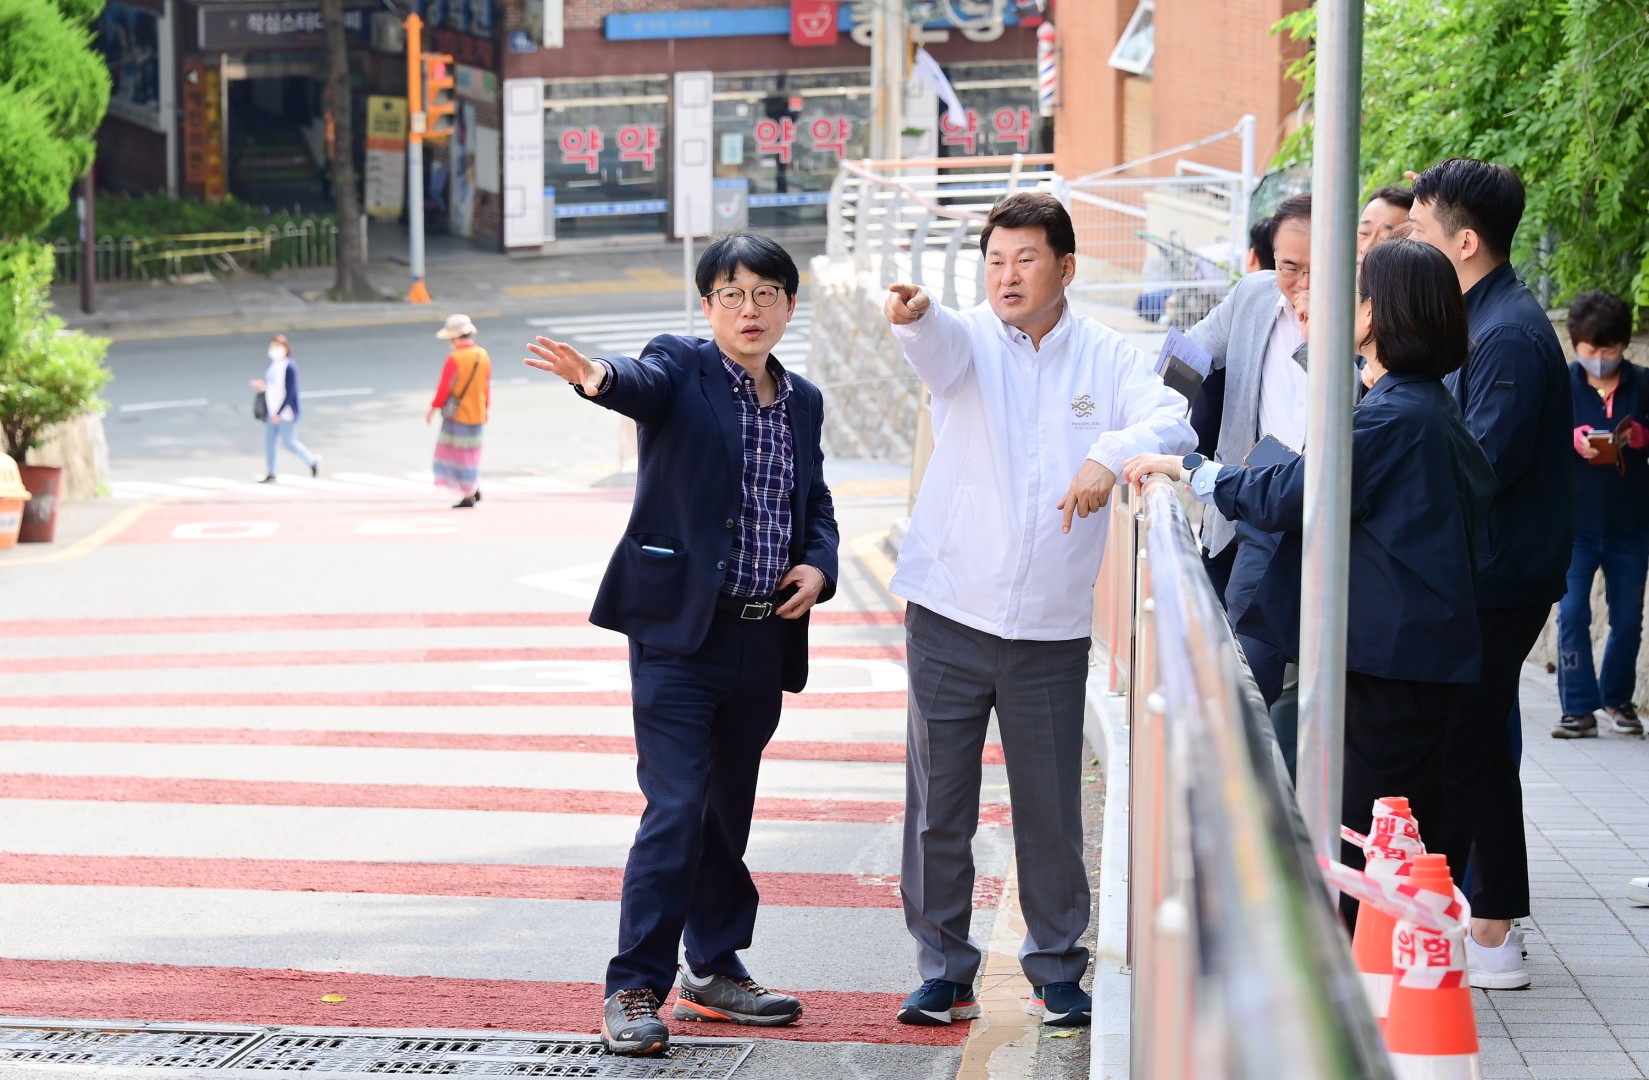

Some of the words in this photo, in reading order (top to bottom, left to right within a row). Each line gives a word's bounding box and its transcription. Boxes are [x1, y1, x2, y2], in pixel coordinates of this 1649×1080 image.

[559, 126, 604, 173] 약
[616, 124, 660, 171] 약
[754, 116, 796, 163] 약
[810, 116, 853, 161] 약
[940, 107, 980, 154] 약
[993, 105, 1032, 152] 약
[1398, 929, 1451, 967] 위험
